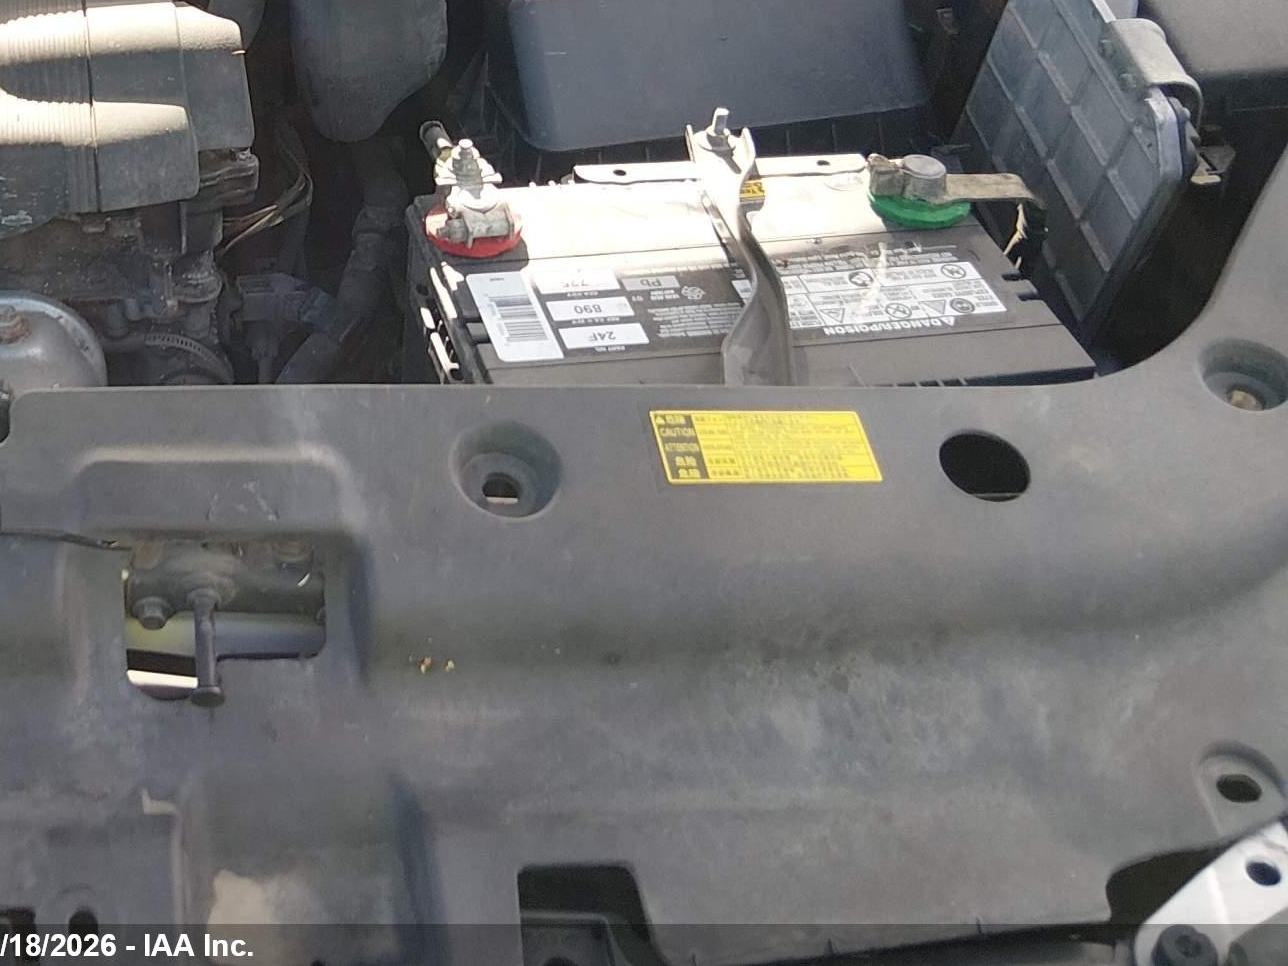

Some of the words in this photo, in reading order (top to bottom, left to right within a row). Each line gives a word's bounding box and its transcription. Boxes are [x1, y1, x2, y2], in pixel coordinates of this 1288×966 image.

[639, 278, 662, 288] Pb
[574, 304, 603, 315] 890
[823, 317, 942, 335] DANGER/POISON
[588, 331, 617, 342] 24F
[659, 426, 696, 437] CAUTION
